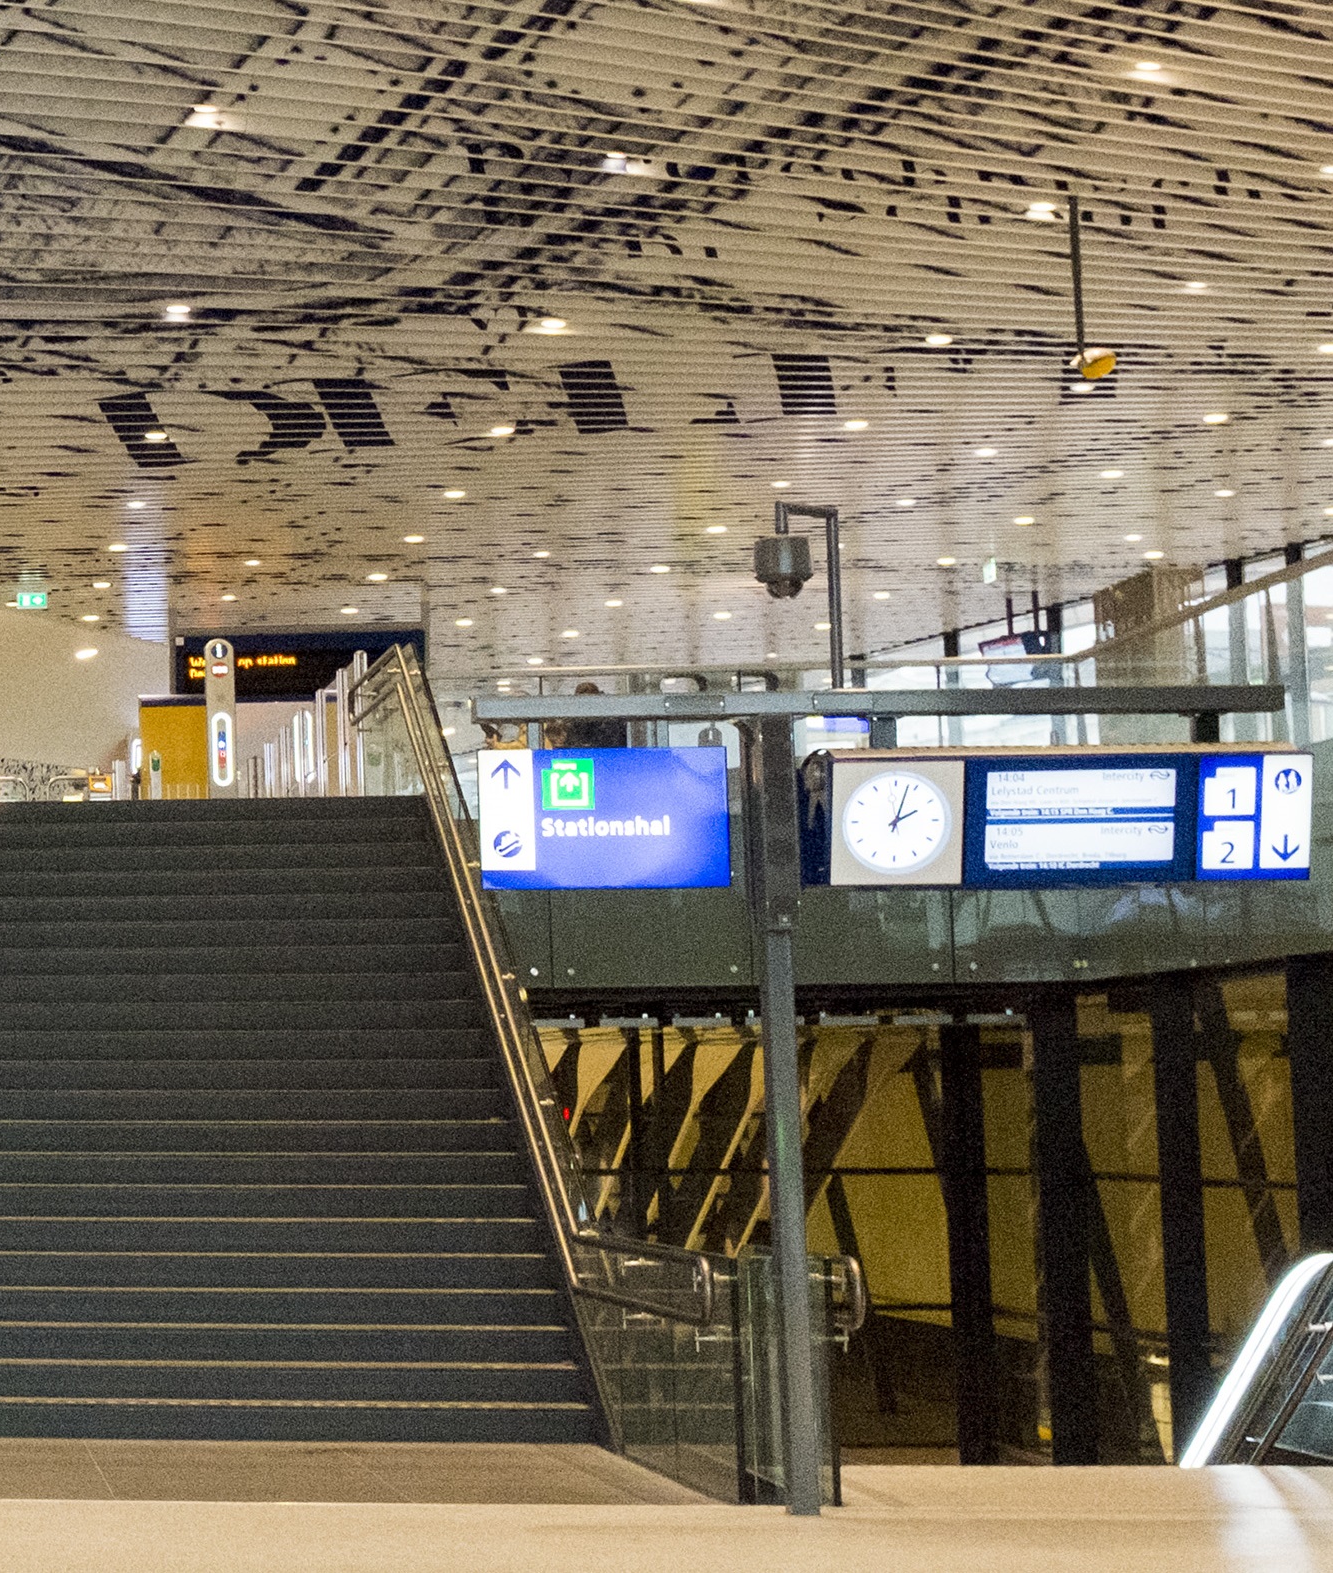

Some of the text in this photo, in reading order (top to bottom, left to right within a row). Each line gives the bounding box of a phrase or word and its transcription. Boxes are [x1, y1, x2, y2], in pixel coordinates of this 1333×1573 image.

[1102, 772, 1145, 783] Intercity
[991, 785, 1079, 798] Lelystad Centrum
[1227, 788, 1236, 809] 1
[541, 815, 671, 837] Stationshal
[1100, 826, 1143, 837] Intercity
[990, 840, 1019, 849] Venlo
[1220, 841, 1235, 864] 2
